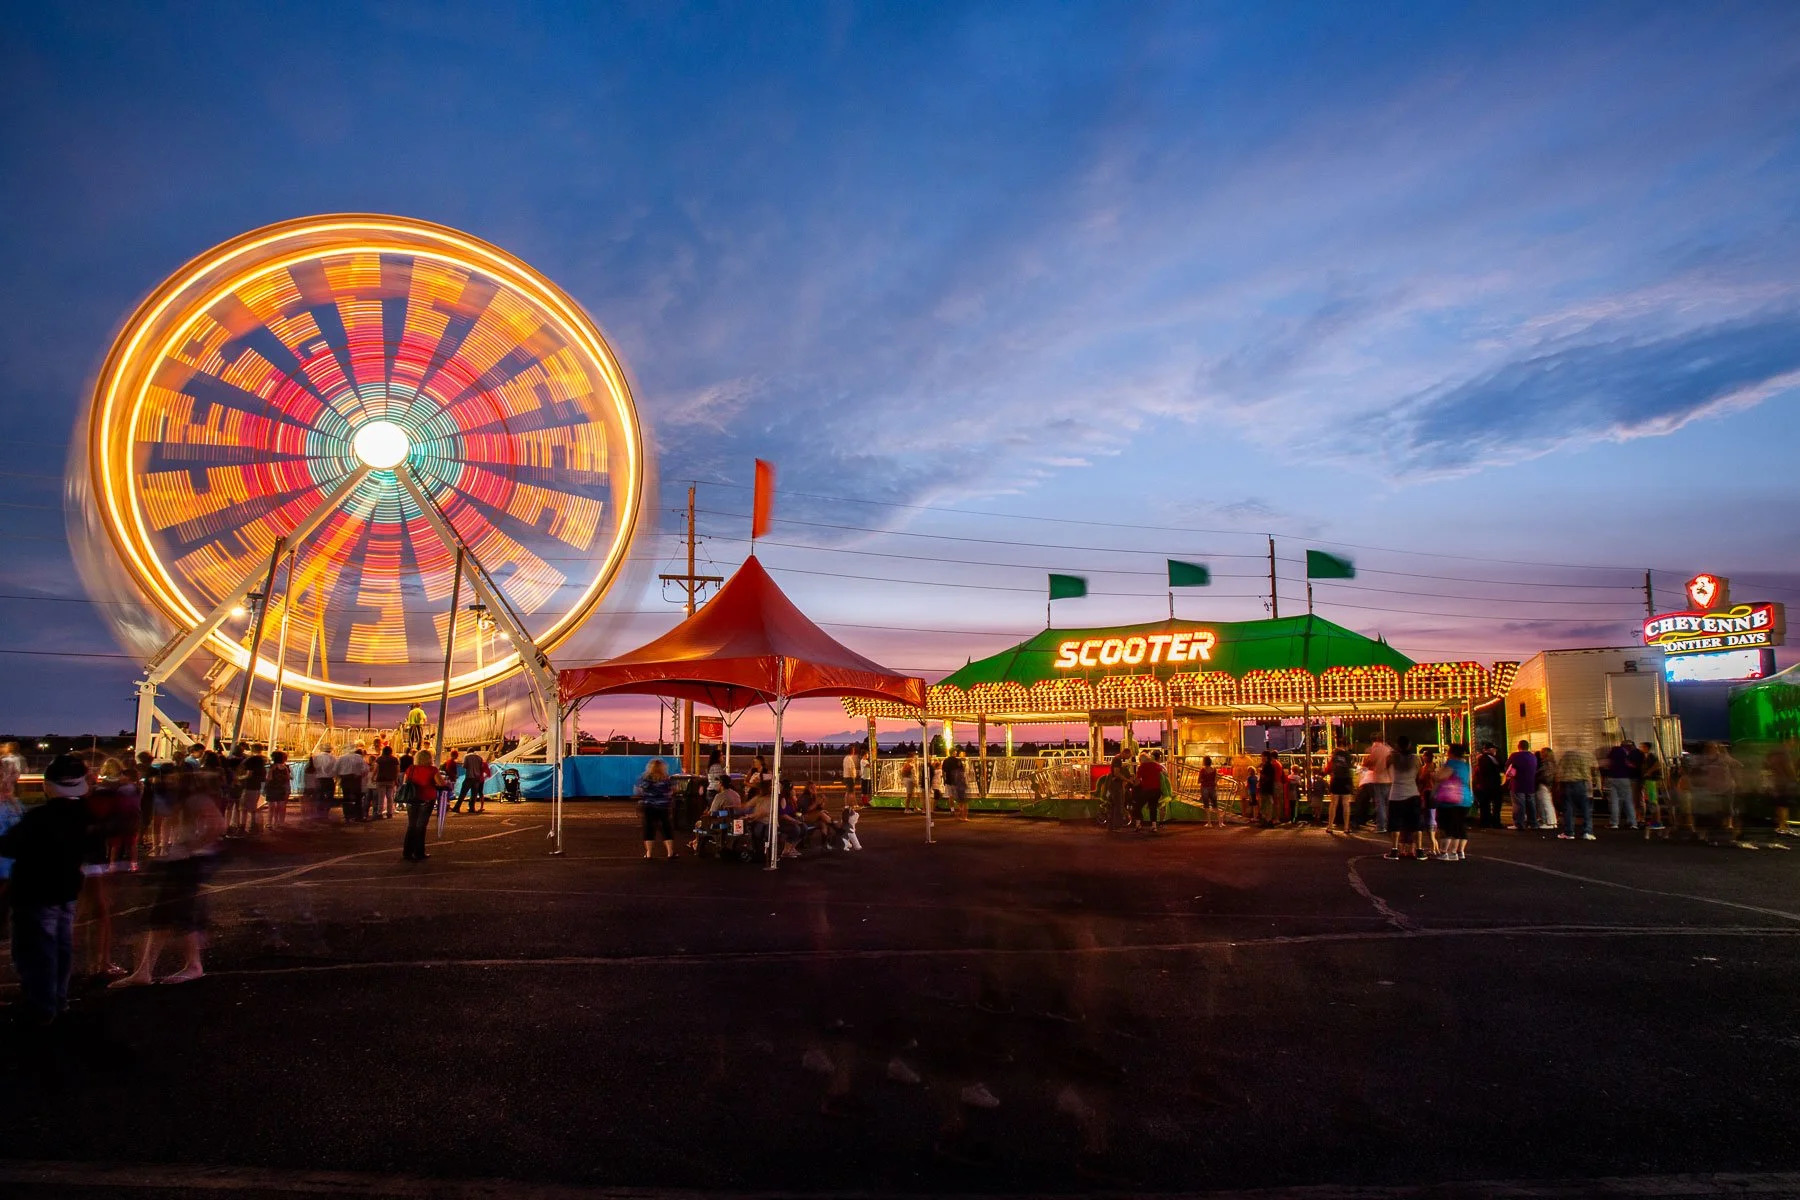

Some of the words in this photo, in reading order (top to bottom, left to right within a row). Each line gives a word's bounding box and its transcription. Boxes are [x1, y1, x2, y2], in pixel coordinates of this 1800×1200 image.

[1645, 610, 1768, 636] CHEYENNE
[1054, 631, 1216, 668] SCOOTER
[1663, 637, 1722, 652] ONTIER
[1727, 632, 1766, 646] DAYS
